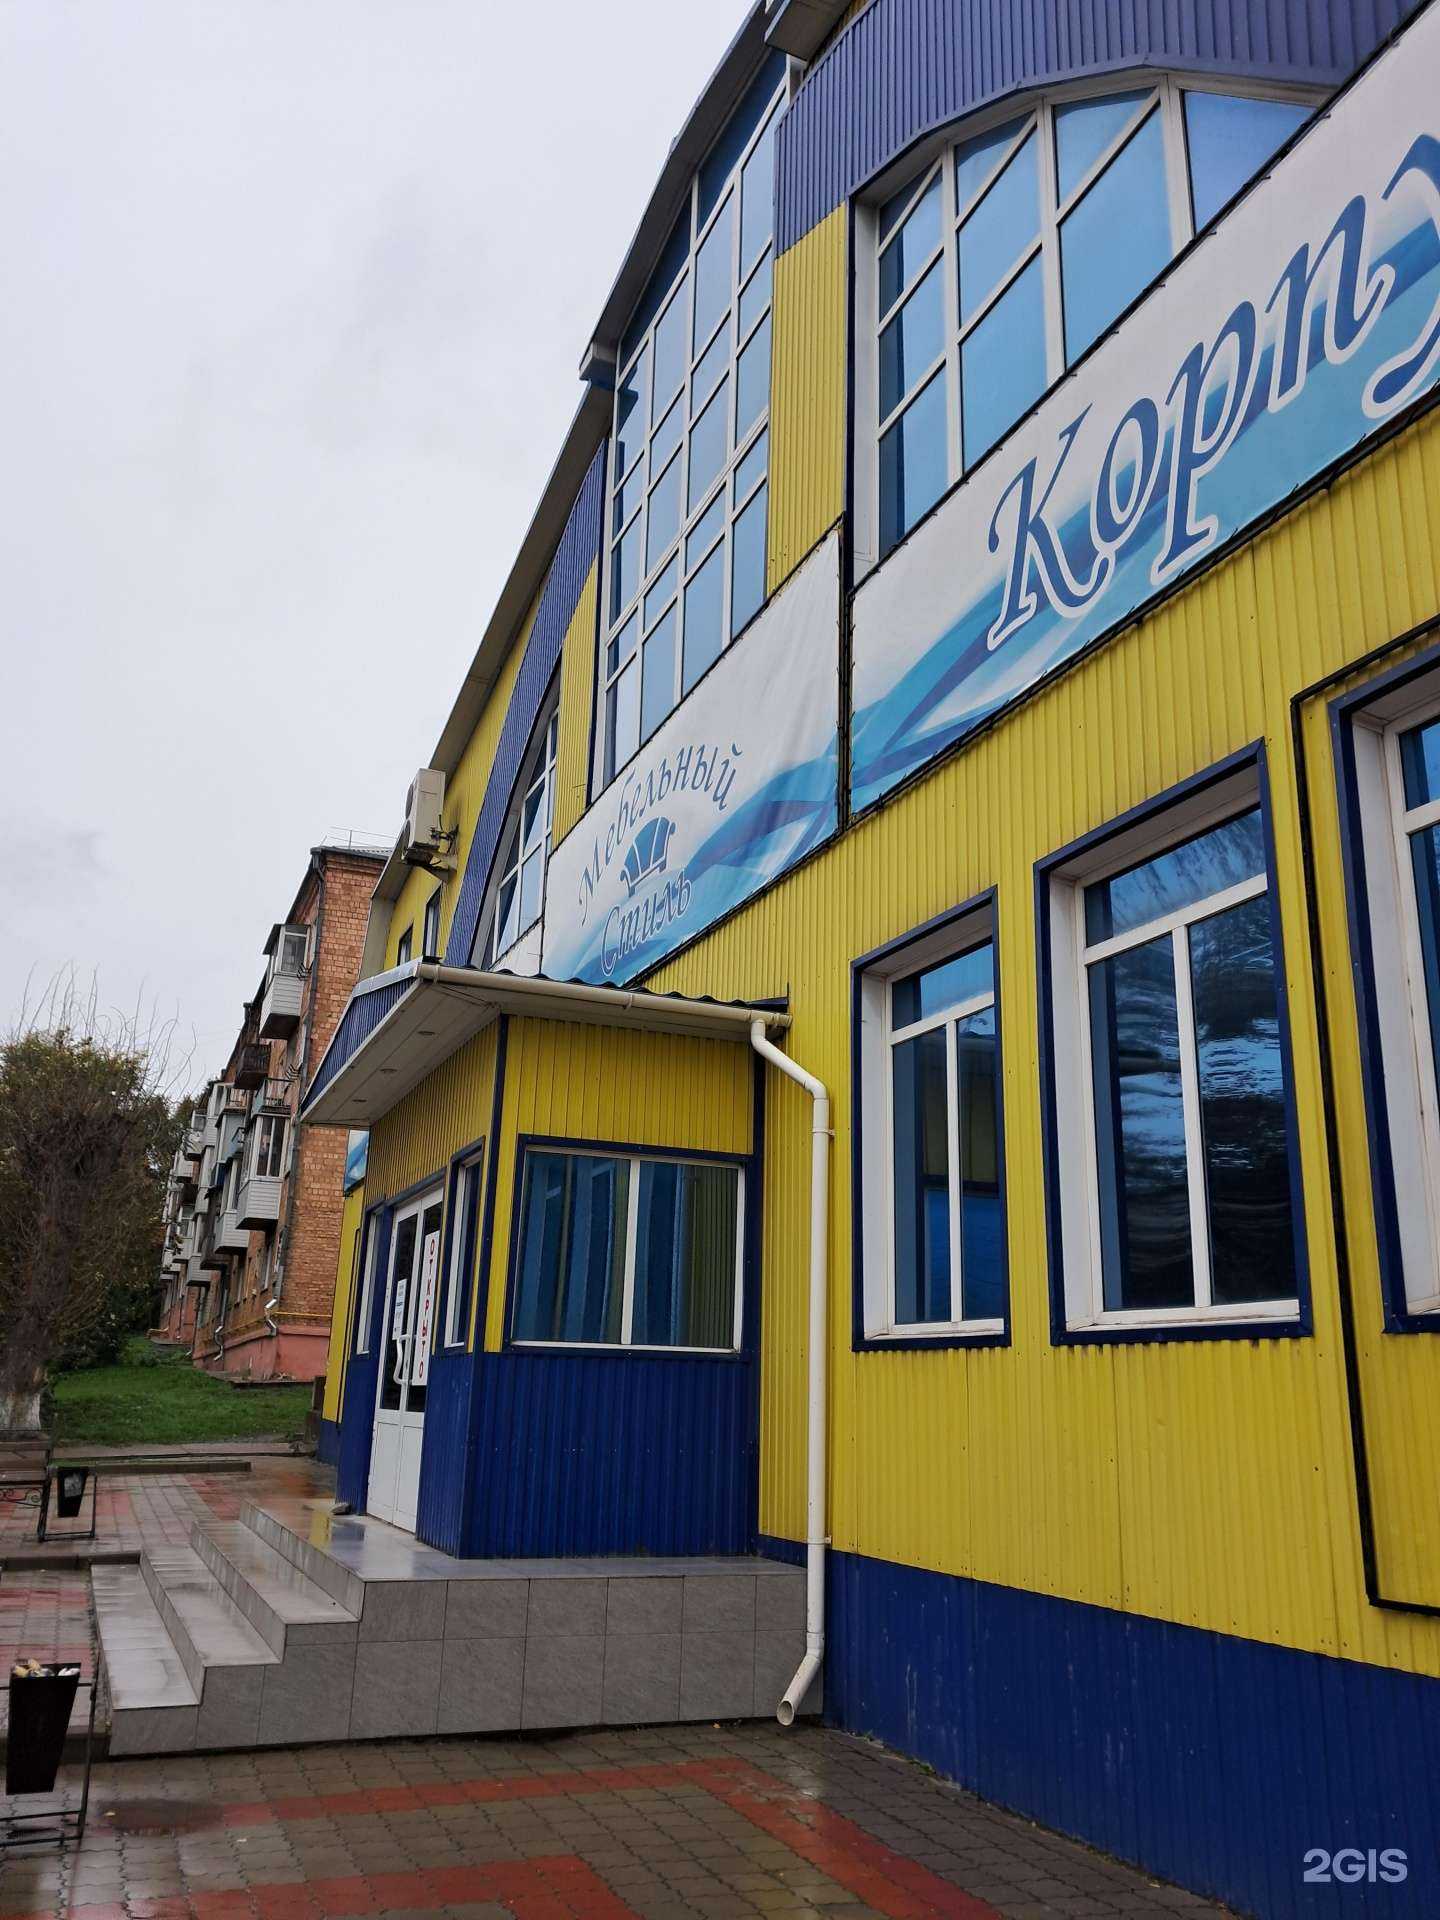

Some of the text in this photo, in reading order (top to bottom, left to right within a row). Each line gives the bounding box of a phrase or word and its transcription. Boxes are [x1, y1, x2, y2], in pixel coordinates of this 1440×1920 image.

[578, 743, 743, 926] Мебельный
[601, 868, 693, 977] Стиль
[418, 1238, 436, 1379] ОТКРЫТО
